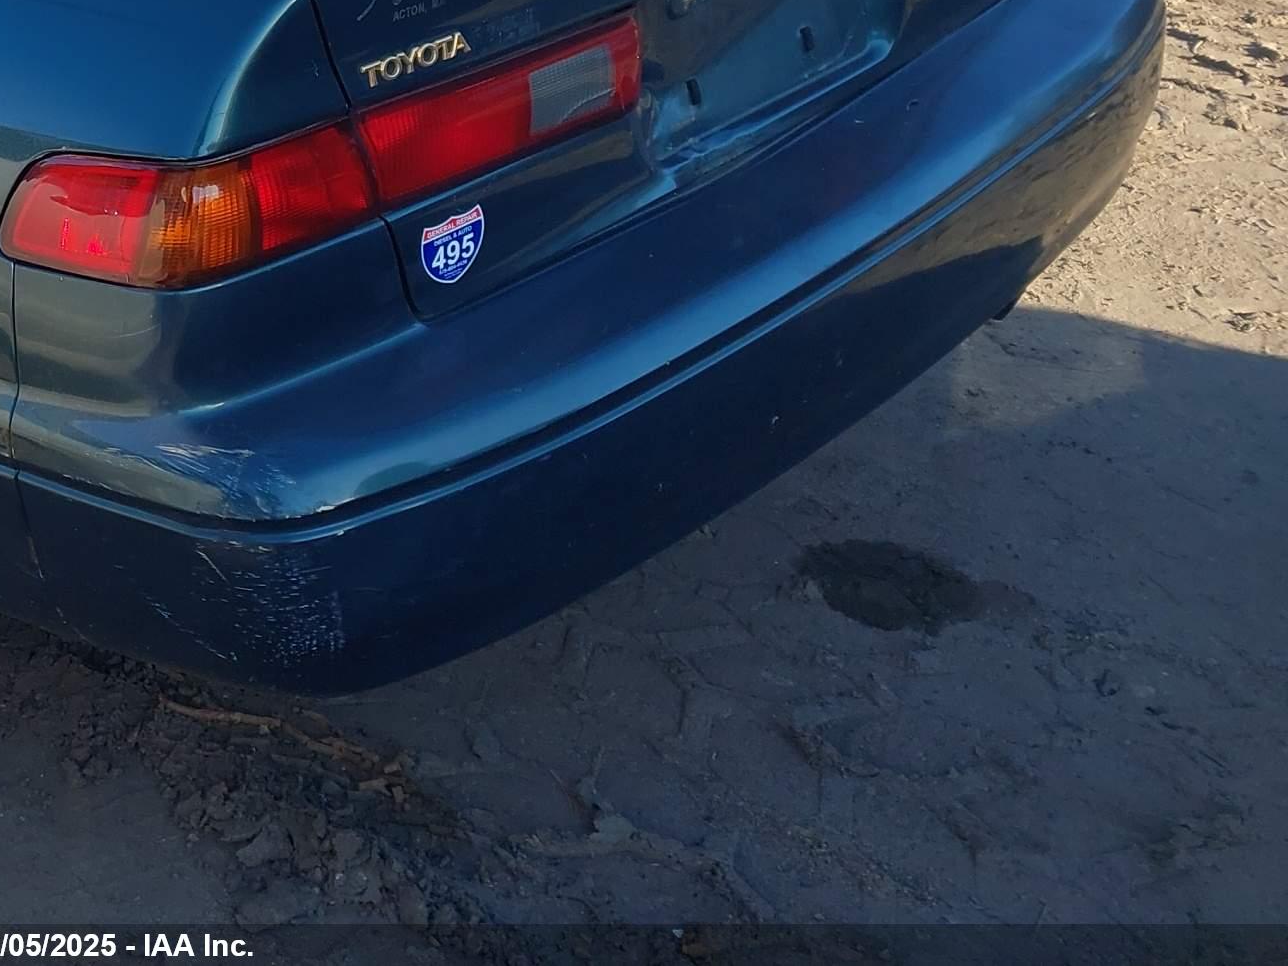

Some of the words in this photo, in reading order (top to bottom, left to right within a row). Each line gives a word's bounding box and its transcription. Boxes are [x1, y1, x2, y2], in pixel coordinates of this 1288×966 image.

[360, 31, 472, 88] TOYOTA
[426, 221, 457, 239] GENERAL
[455, 211, 478, 226] REPAIR
[458, 225, 473, 237] AUTO
[431, 232, 475, 270] 495
